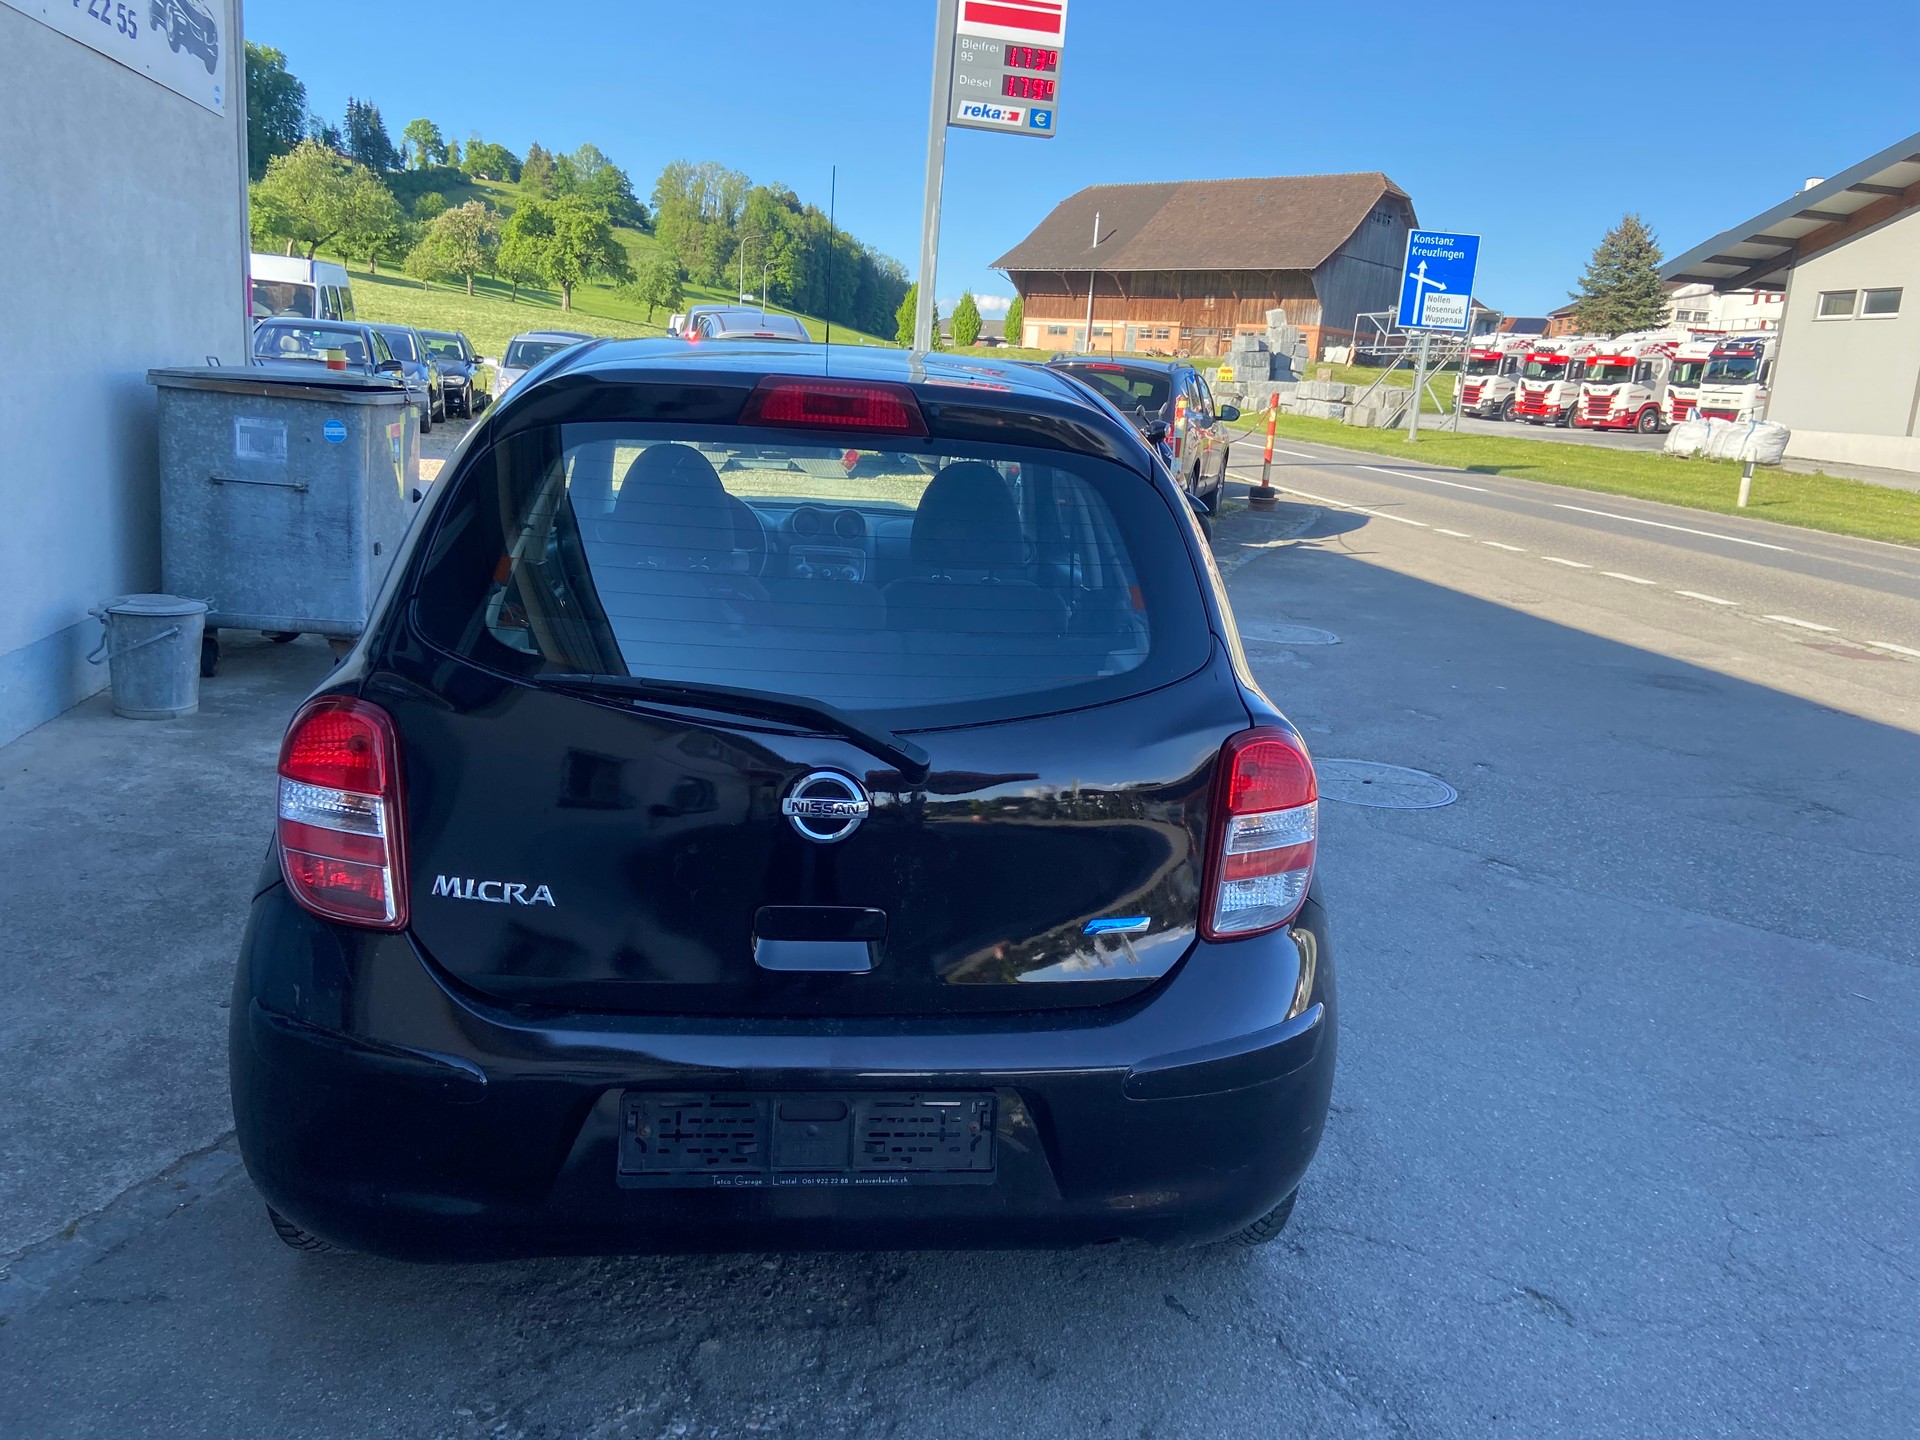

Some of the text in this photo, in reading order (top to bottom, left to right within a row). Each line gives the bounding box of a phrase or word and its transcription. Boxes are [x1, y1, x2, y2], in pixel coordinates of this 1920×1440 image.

[117, 3, 138, 39] 55
[962, 39, 999, 53] Bleifrei
[960, 51, 974, 62] 95
[959, 74, 992, 88] Diesel
[1413, 234, 1455, 246] Konstanz
[1411, 246, 1465, 261] Kreuzlingen
[1427, 295, 1451, 304] Nollen
[1426, 305, 1463, 315] Hosenruck
[1424, 314, 1463, 324] Wuppenau
[791, 801, 860, 815] NISSAN
[431, 874, 556, 907] MICRA
[734, 1174, 763, 1187] Garage
[772, 1175, 797, 1186] Liestal
